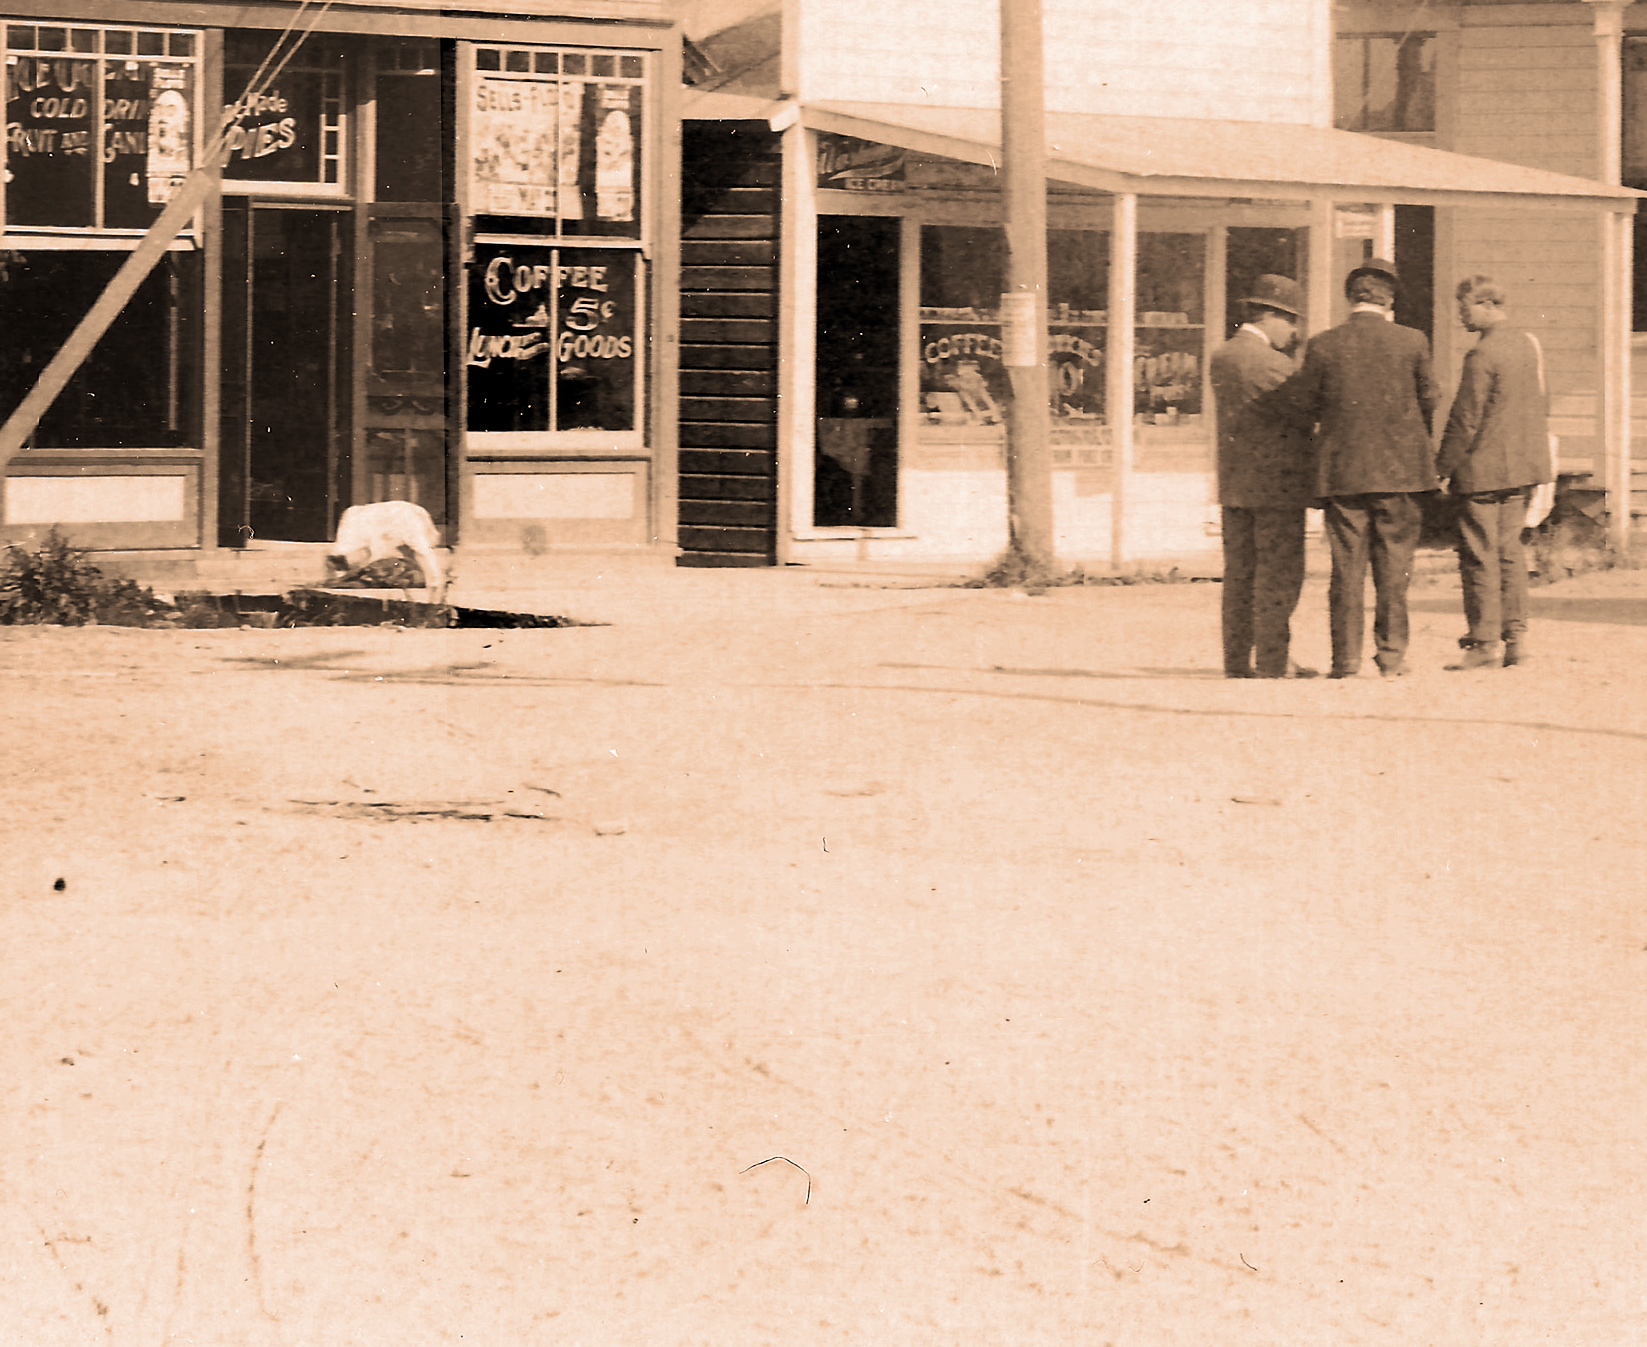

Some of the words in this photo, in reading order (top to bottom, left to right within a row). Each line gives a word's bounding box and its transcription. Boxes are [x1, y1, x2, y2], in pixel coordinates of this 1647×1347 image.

[30, 97, 87, 119] COLD
[485, 257, 610, 305] COFFEE
[558, 330, 632, 363] GOODS
